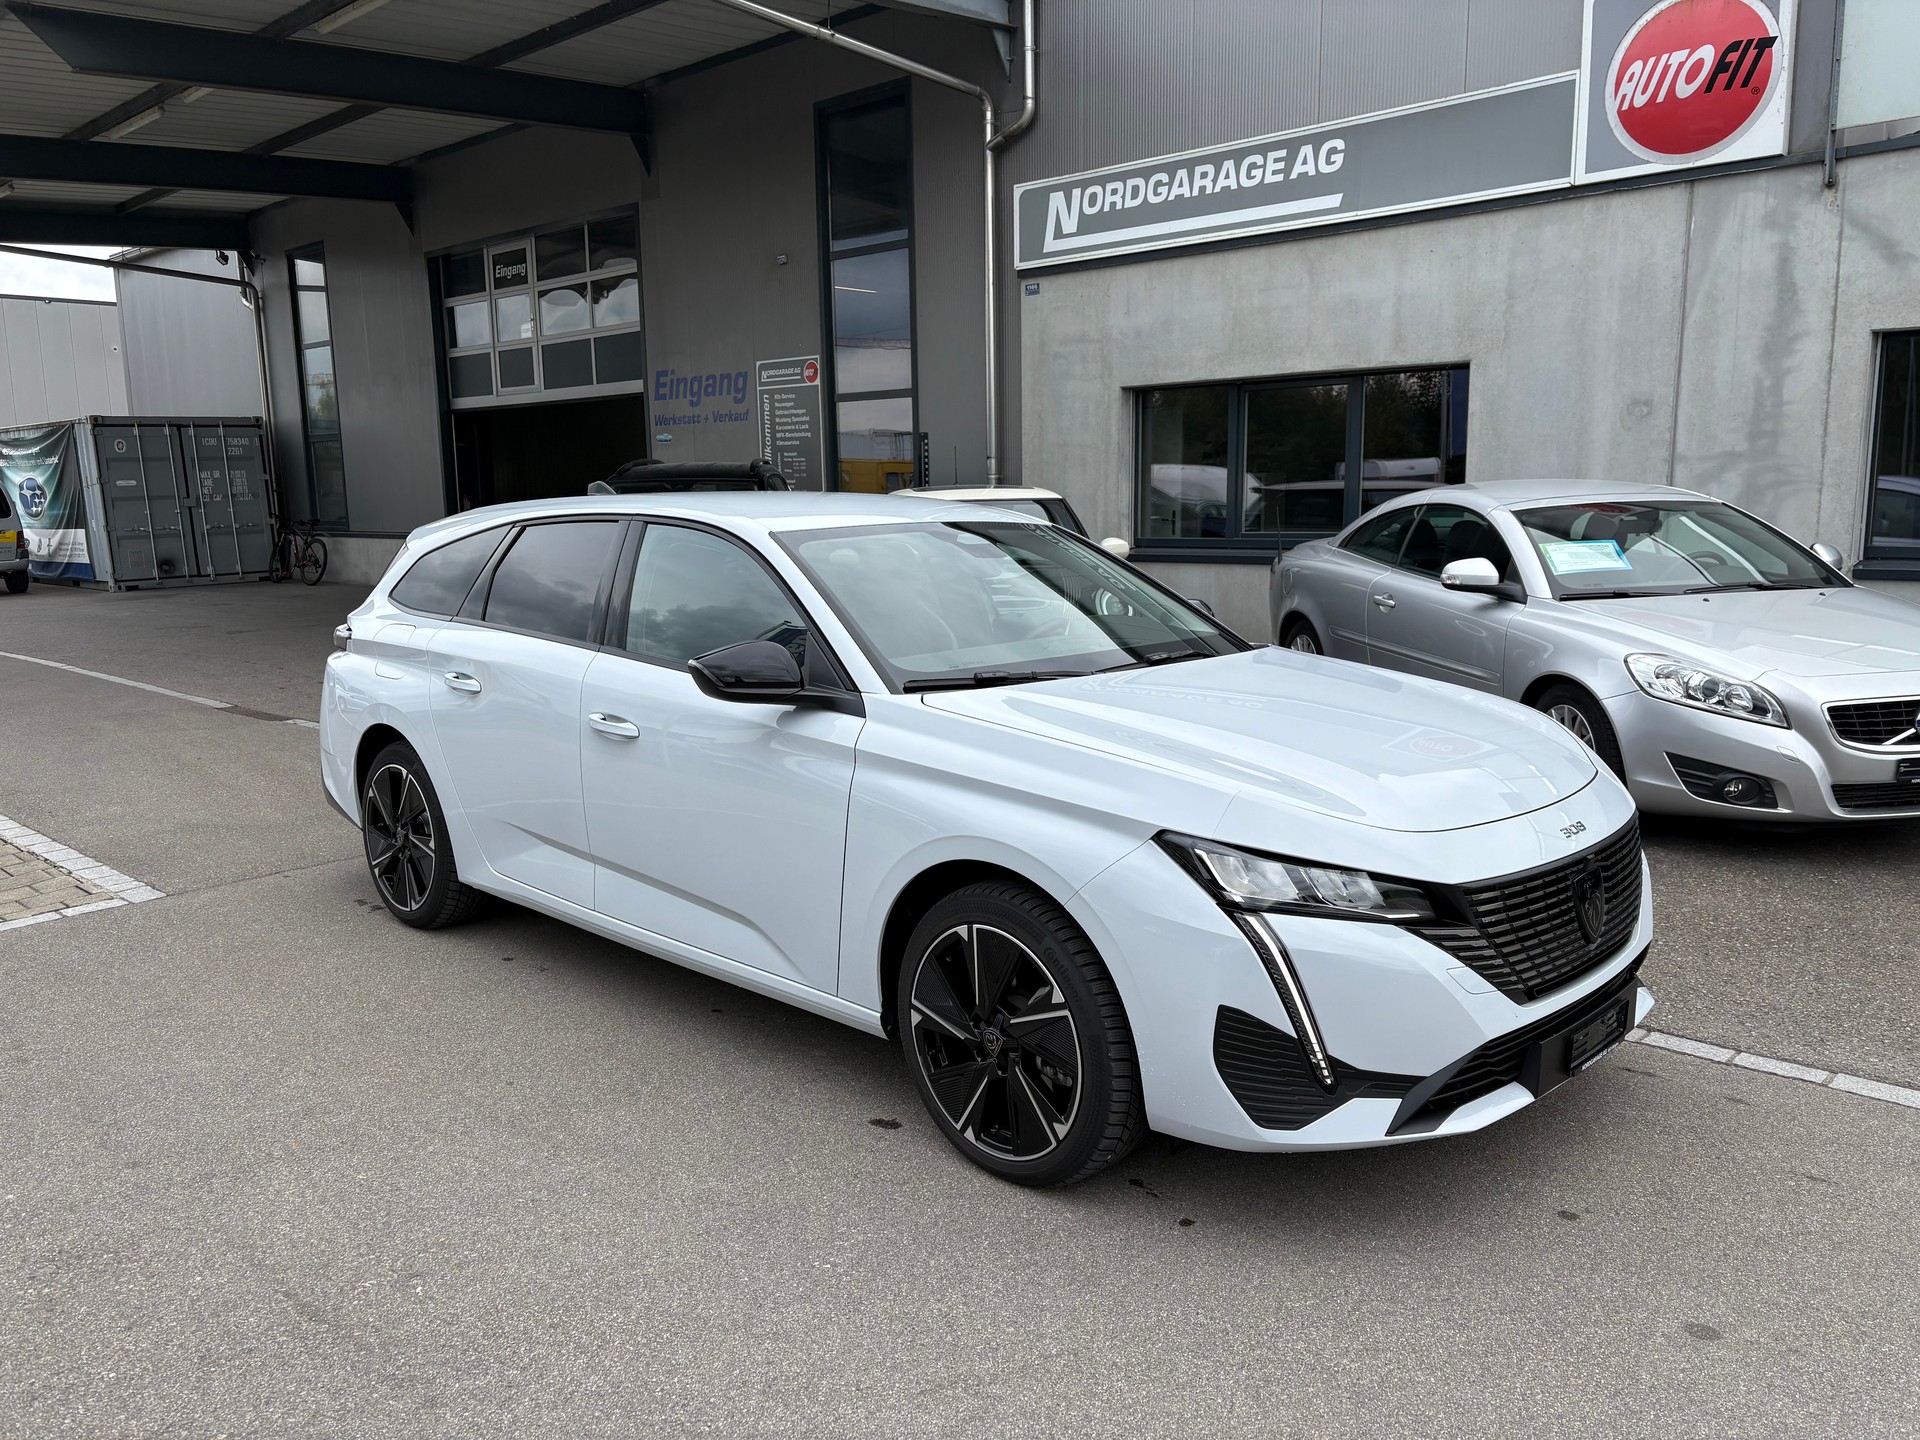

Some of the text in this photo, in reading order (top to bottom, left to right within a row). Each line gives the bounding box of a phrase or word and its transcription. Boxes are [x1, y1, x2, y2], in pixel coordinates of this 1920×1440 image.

[1614, 35, 1779, 111] AUTOFIT
[1043, 139, 1346, 236] NORDGARAGE AG
[495, 263, 526, 279] Eingang
[761, 368, 794, 379] NORDGARAGE
[654, 369, 749, 408] Eingang
[654, 413, 701, 426] Werkstatt
[712, 409, 750, 423] Verkauf
[1560, 821, 1587, 839] 308
